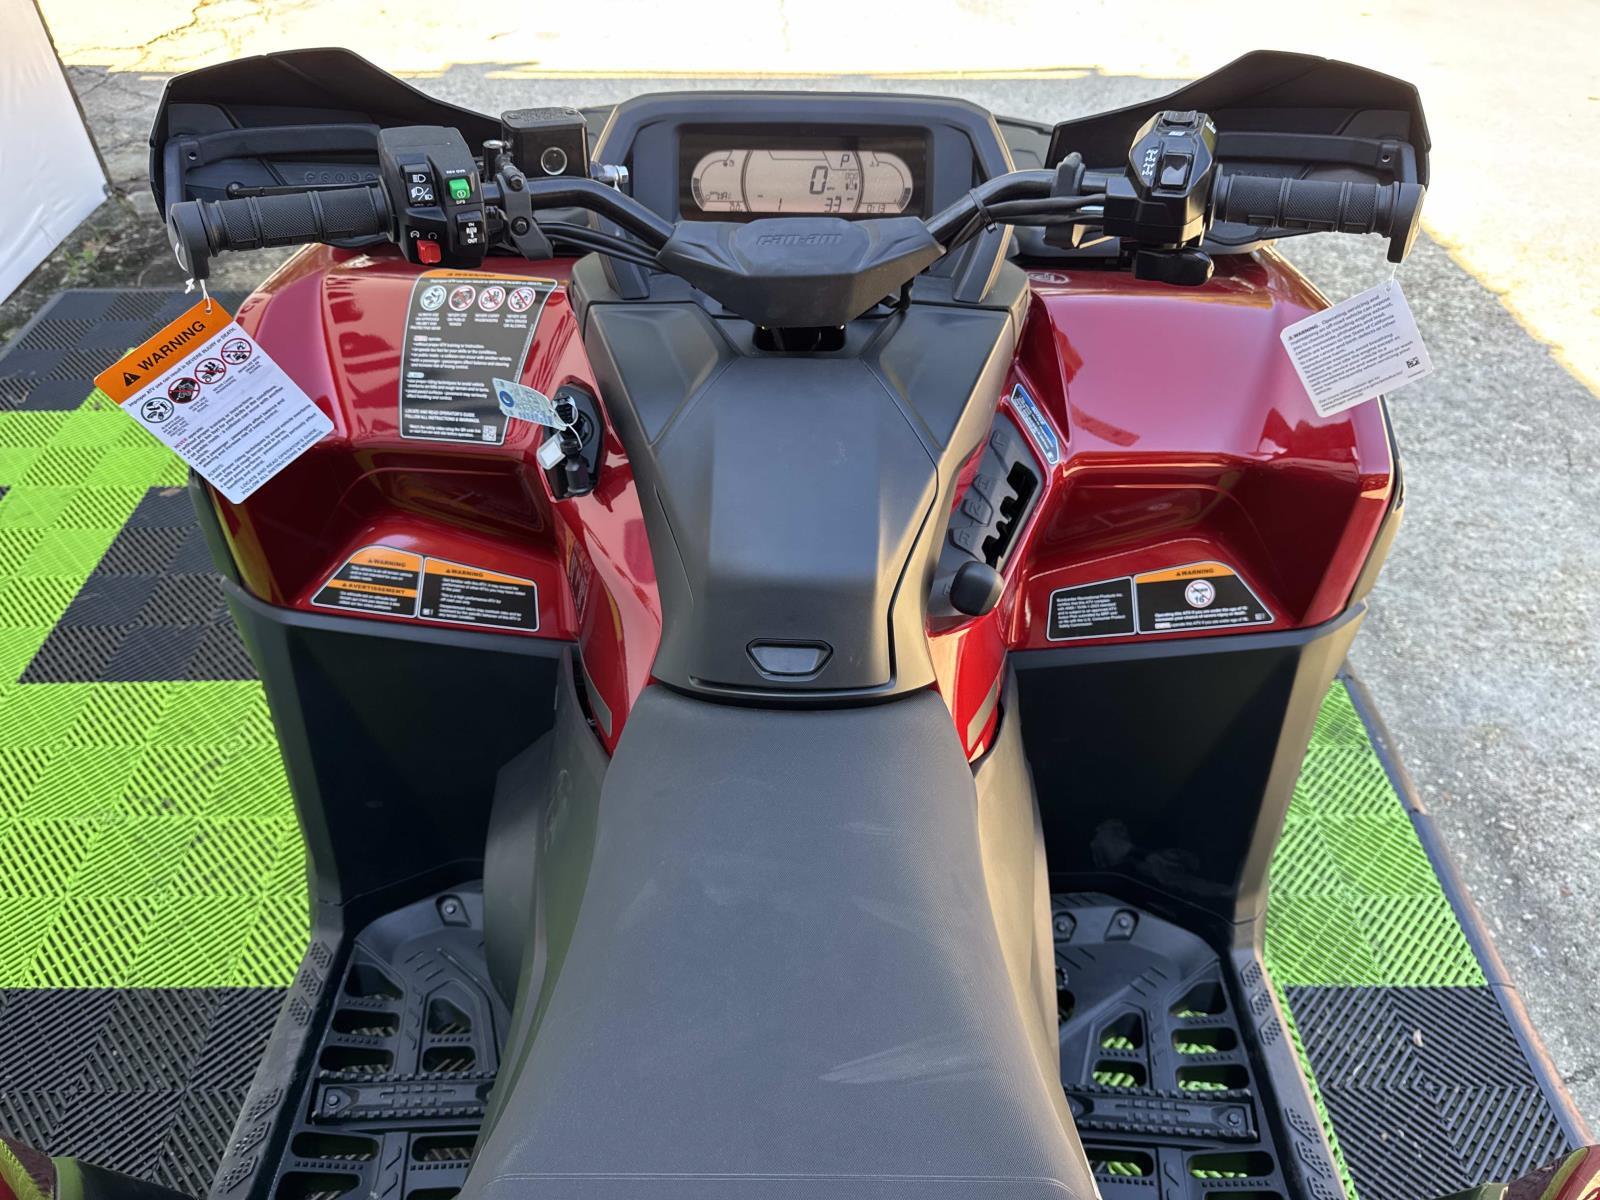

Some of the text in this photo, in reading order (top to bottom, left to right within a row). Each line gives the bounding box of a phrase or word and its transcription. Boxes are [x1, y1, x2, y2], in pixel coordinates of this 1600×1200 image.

[841, 154, 850, 167] P
[809, 166, 829, 194] 0
[137, 320, 206, 372] WARNING
[145, 386, 155, 394] ATV
[258, 472, 268, 481] ALL
[374, 559, 406, 567] WARNING
[452, 569, 484, 577] WARNING
[1182, 568, 1214, 576] WARNING
